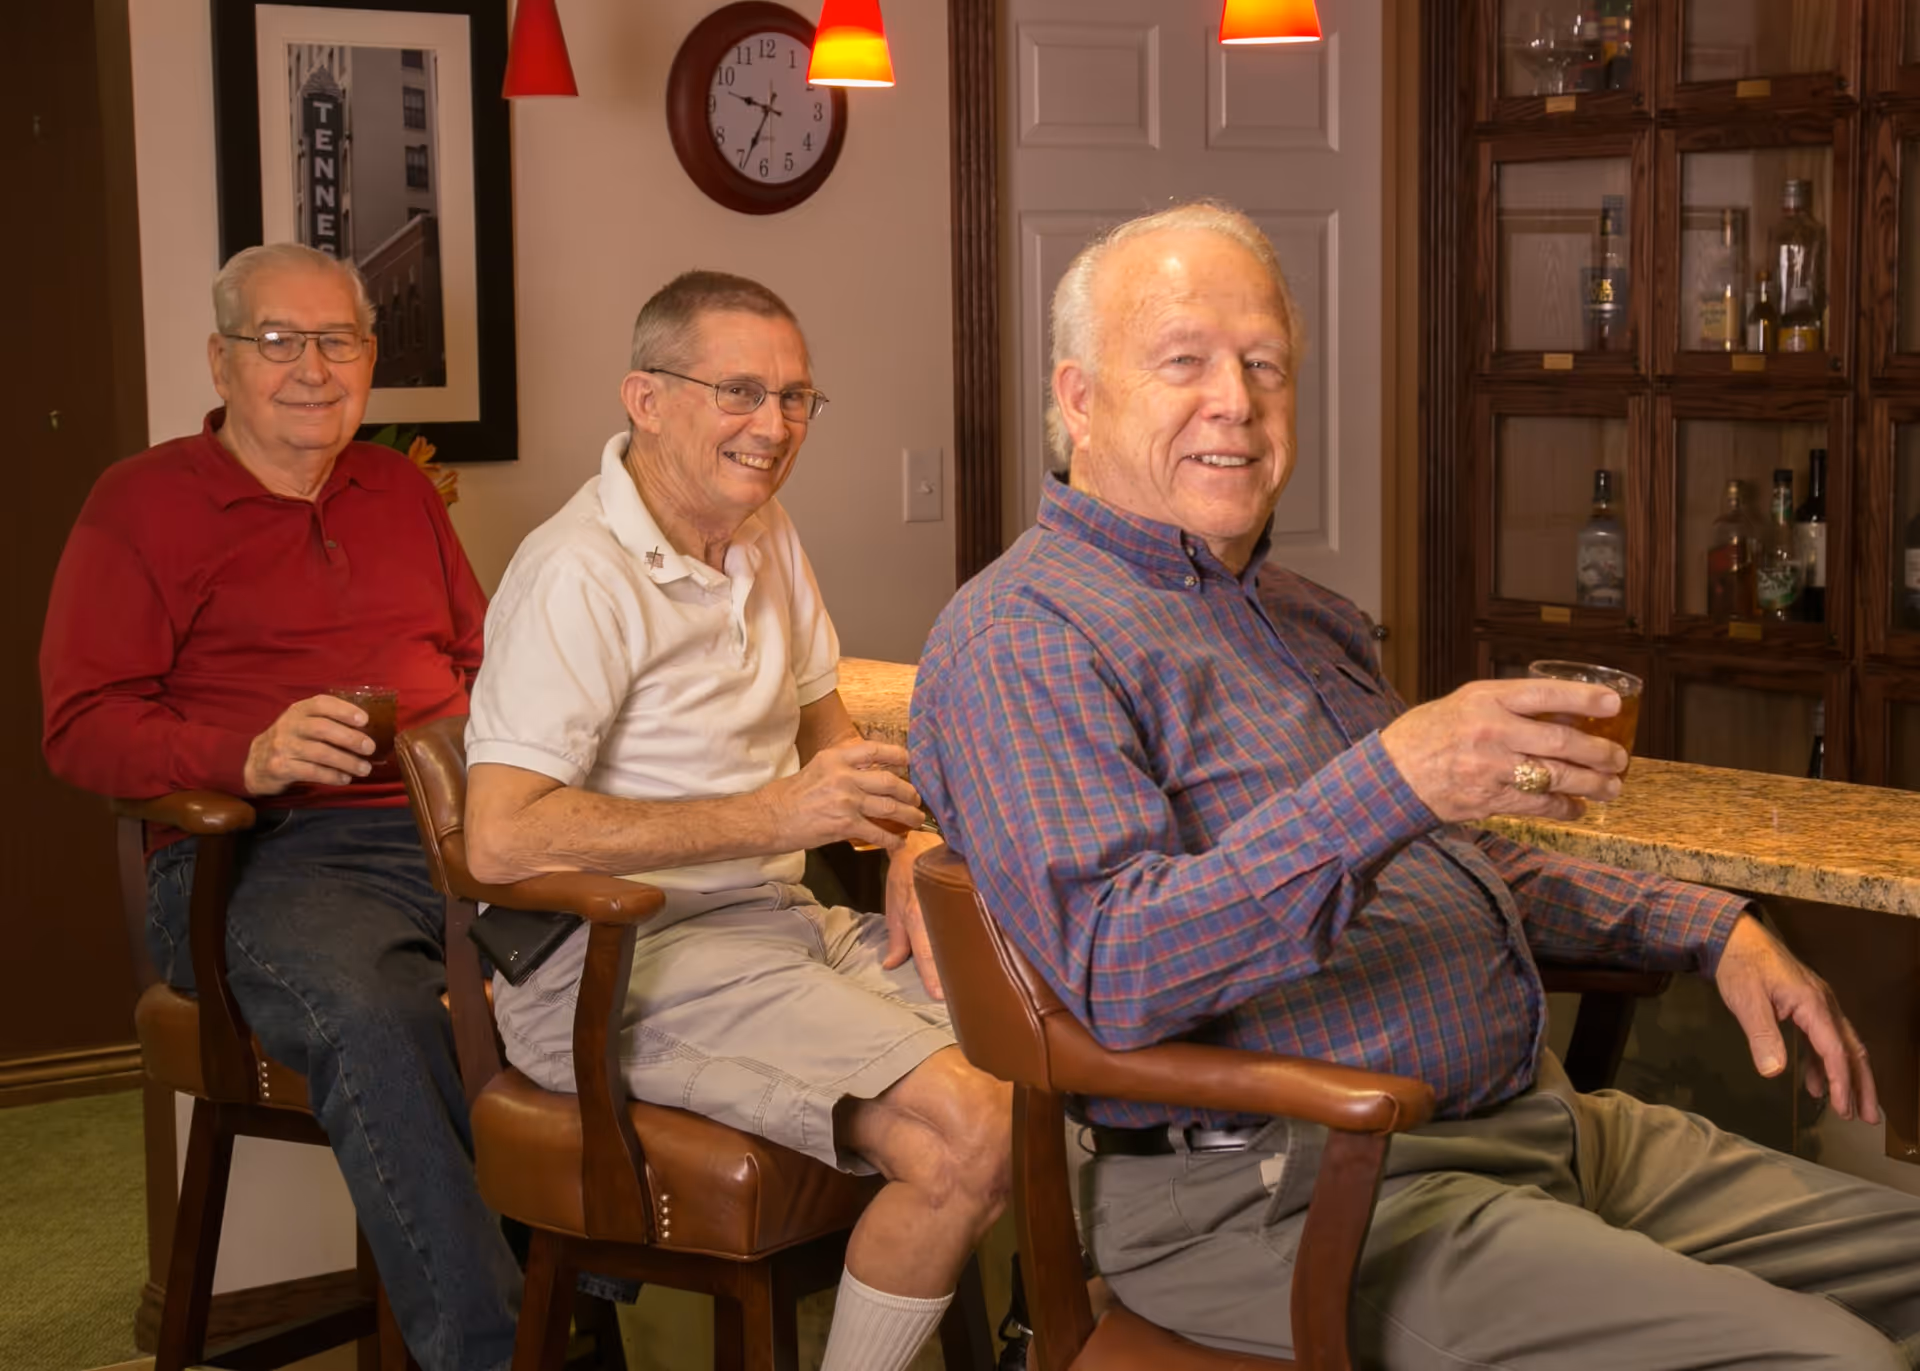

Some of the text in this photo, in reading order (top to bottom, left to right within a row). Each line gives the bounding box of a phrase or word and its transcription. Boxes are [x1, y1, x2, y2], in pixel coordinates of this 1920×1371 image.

[736, 46, 752, 65] 11
[759, 39, 776, 58] 12
[788, 49, 798, 69] 1
[718, 66, 735, 86] 10
[708, 94, 717, 114] 9
[813, 102, 823, 121] 3
[716, 126, 726, 145] 8
[803, 132, 812, 151] 4
[736, 148, 745, 169] 7
[759, 159, 769, 177] 6
[784, 152, 794, 171] 5
